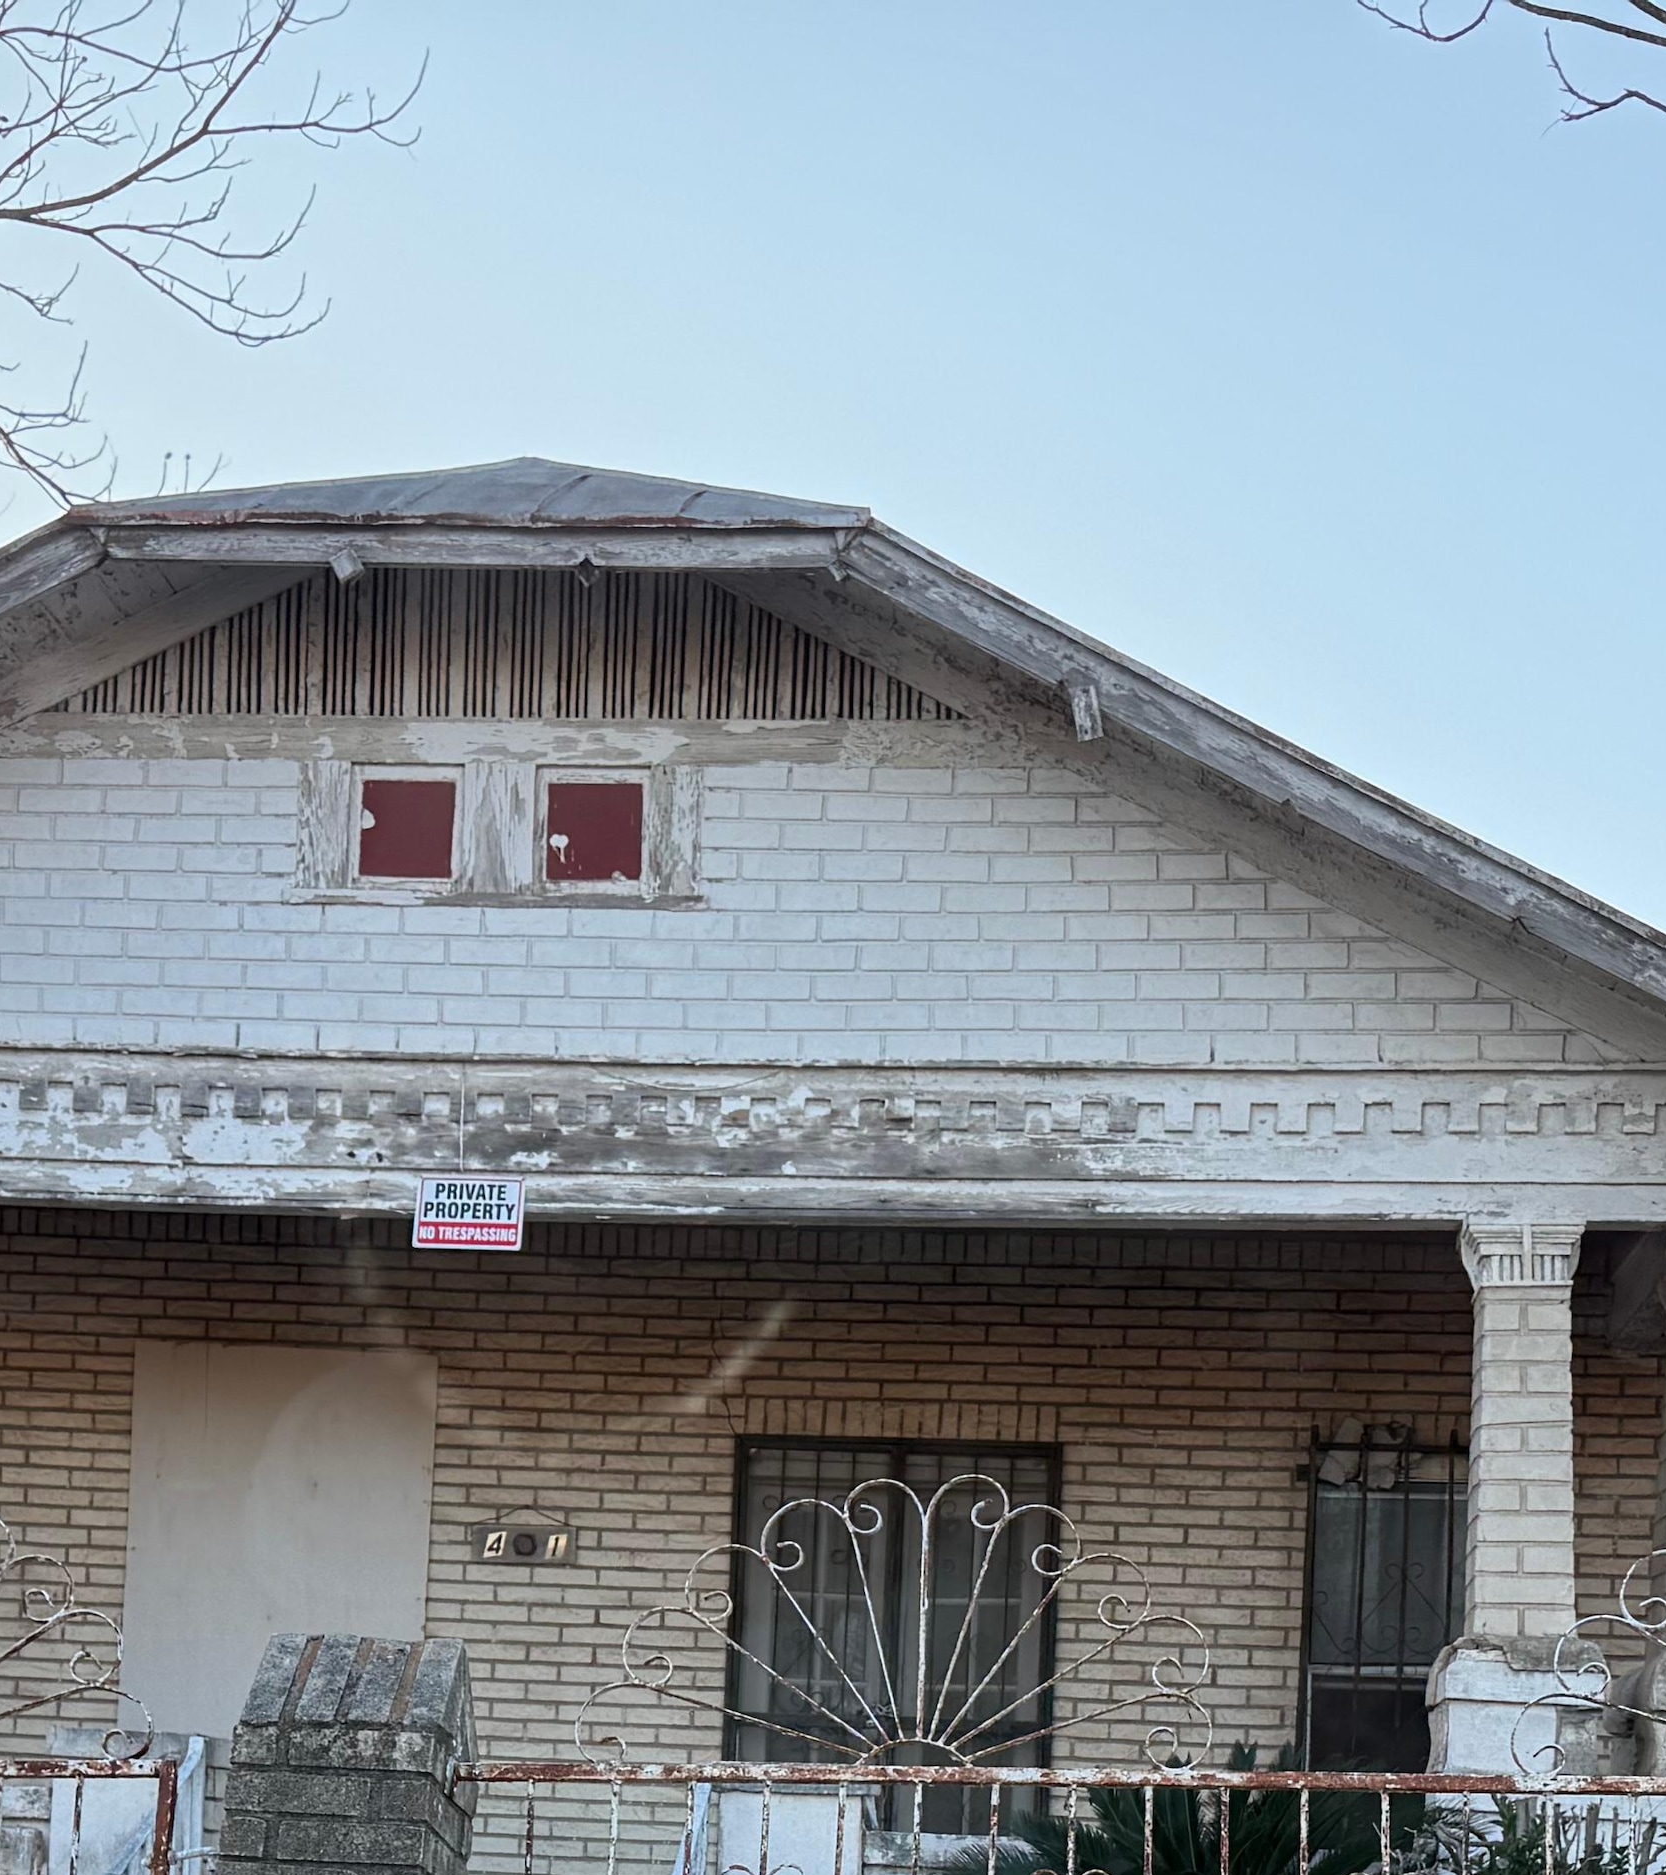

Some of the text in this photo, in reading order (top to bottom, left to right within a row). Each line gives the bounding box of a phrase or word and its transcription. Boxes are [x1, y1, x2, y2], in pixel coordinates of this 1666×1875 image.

[435, 1183, 507, 1201] PRIVATE
[423, 1202, 515, 1220] PROPERTY
[419, 1225, 516, 1242] NO TRESPASSING
